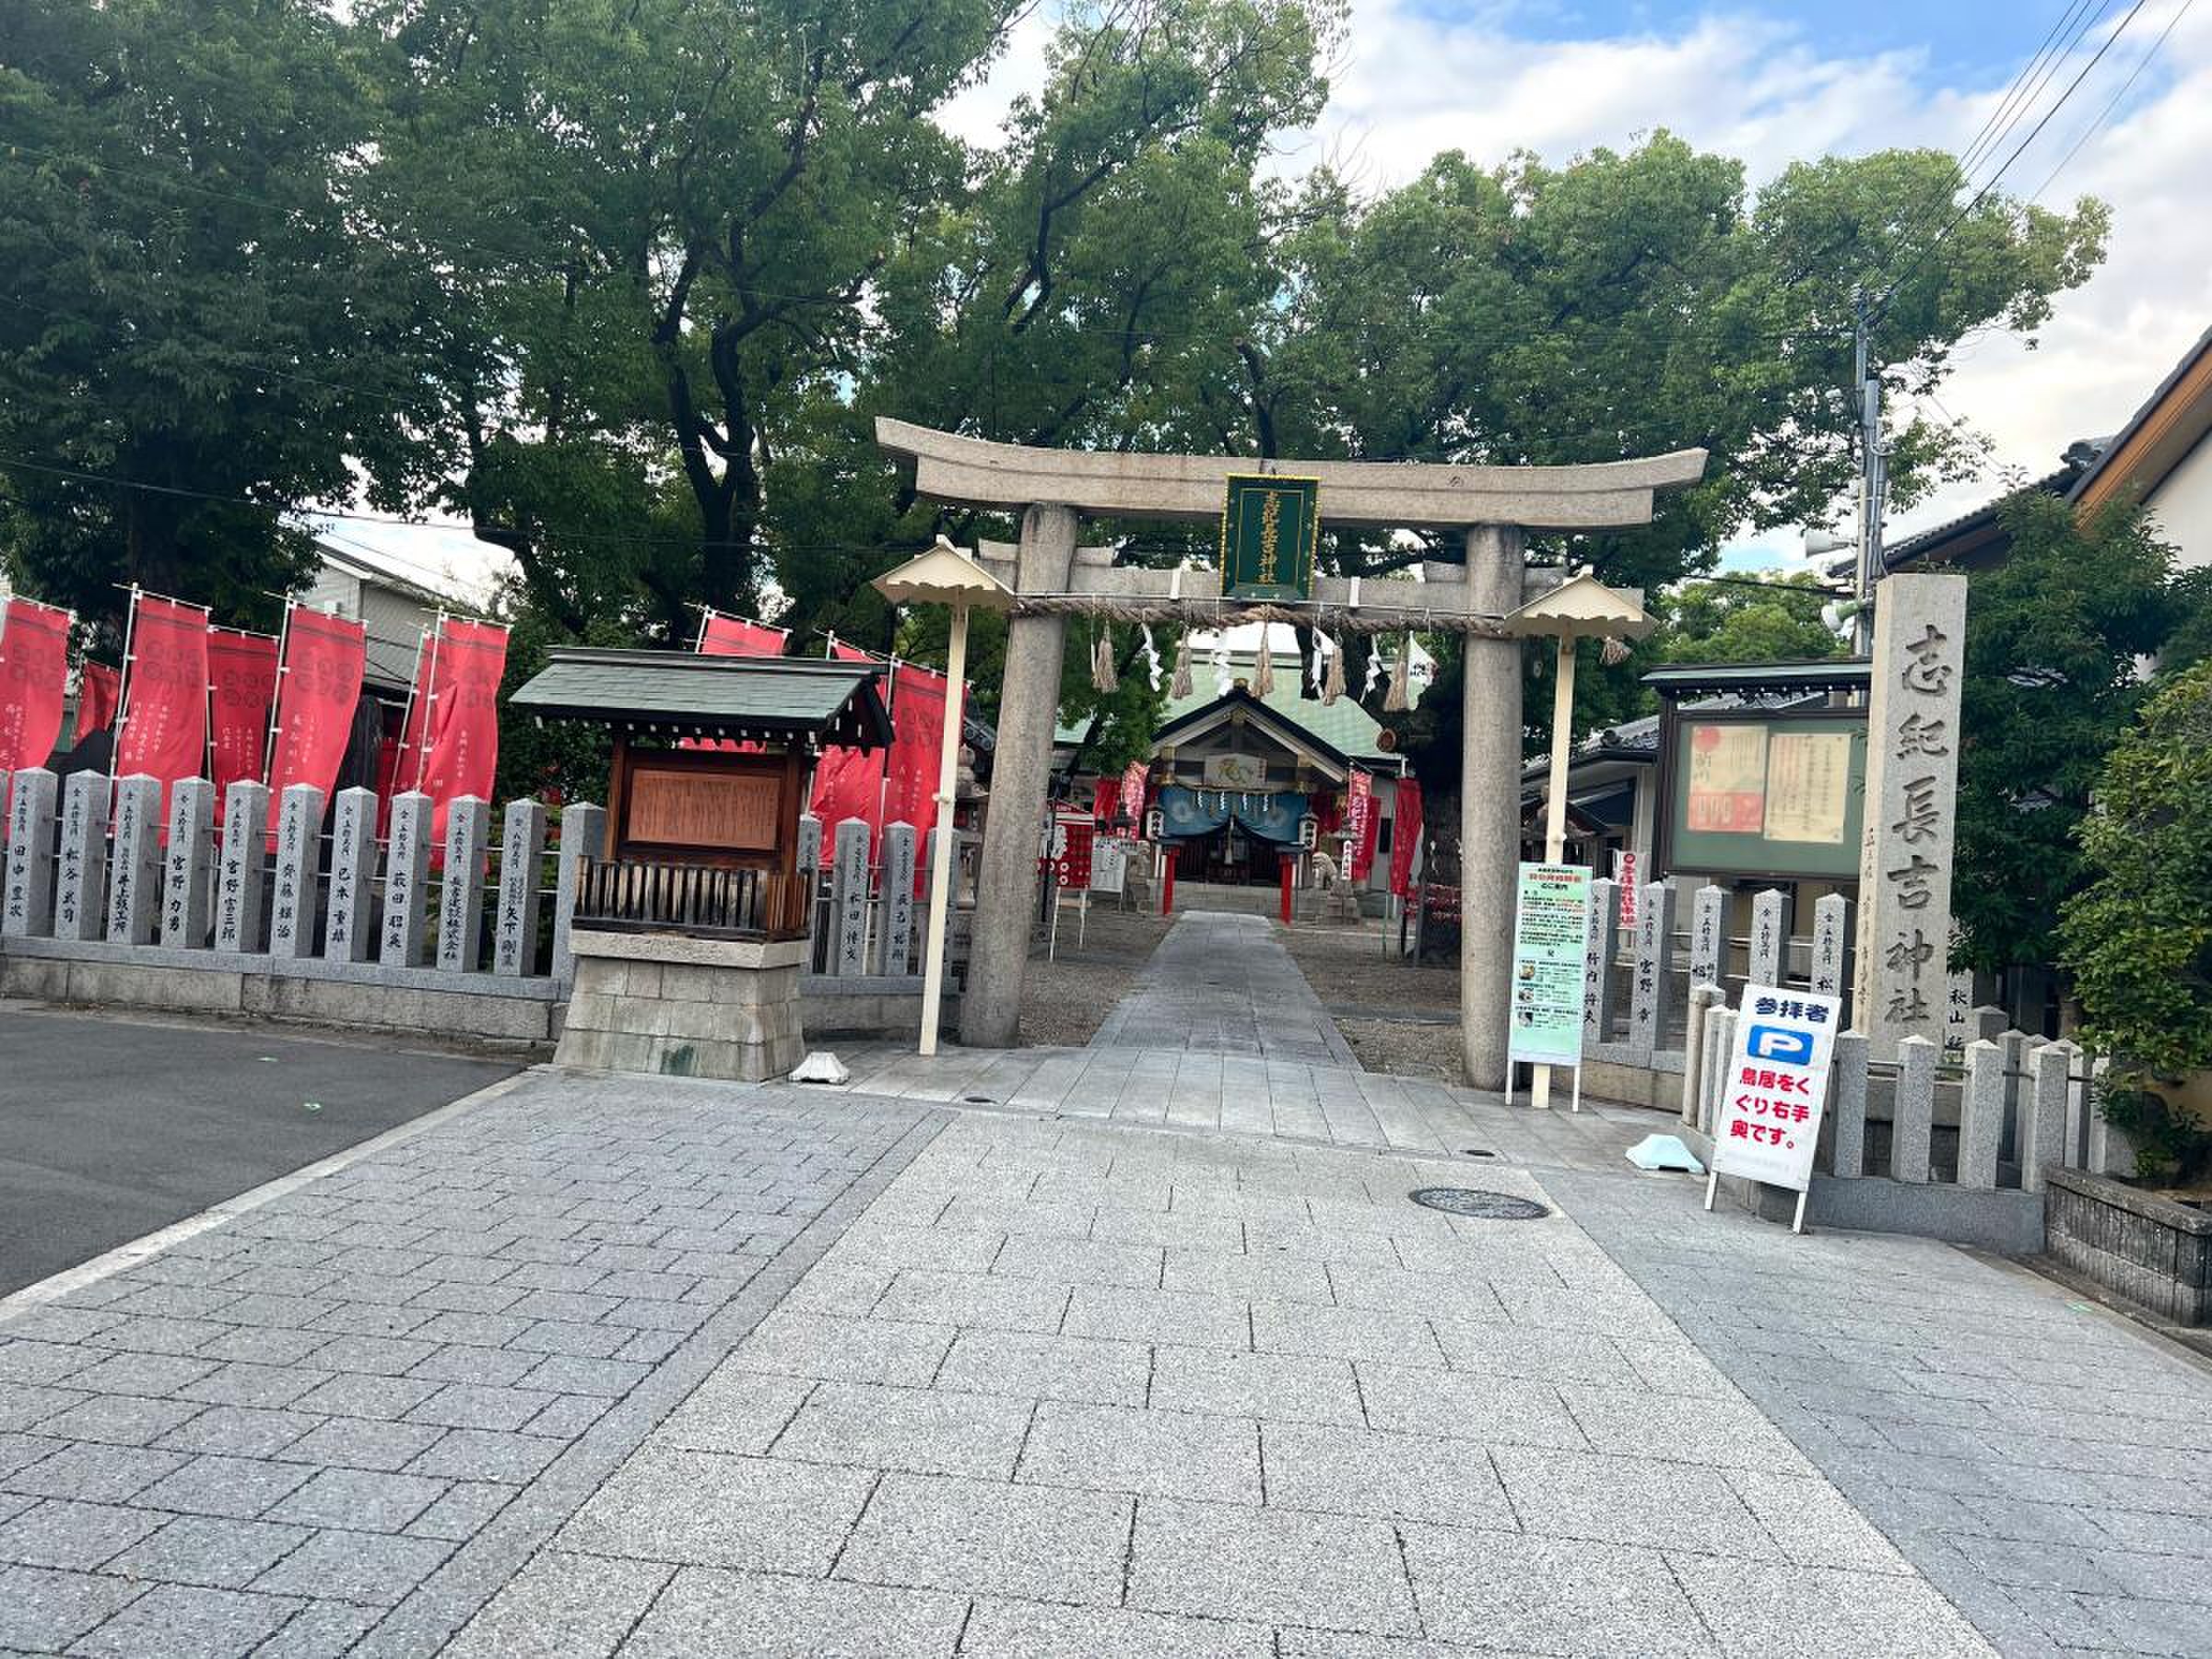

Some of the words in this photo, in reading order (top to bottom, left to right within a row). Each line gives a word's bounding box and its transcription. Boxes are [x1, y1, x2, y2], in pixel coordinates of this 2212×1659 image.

[1885, 624, 1952, 1022] 志紀長吉神社
[1755, 997, 1829, 1023] 参拝者
[1759, 1031, 1803, 1056] P
[1740, 1067, 1809, 1094] 鳥居をく
[1736, 1094, 1809, 1123] ぐり右手
[1730, 1120, 1794, 1149] 奥です。
